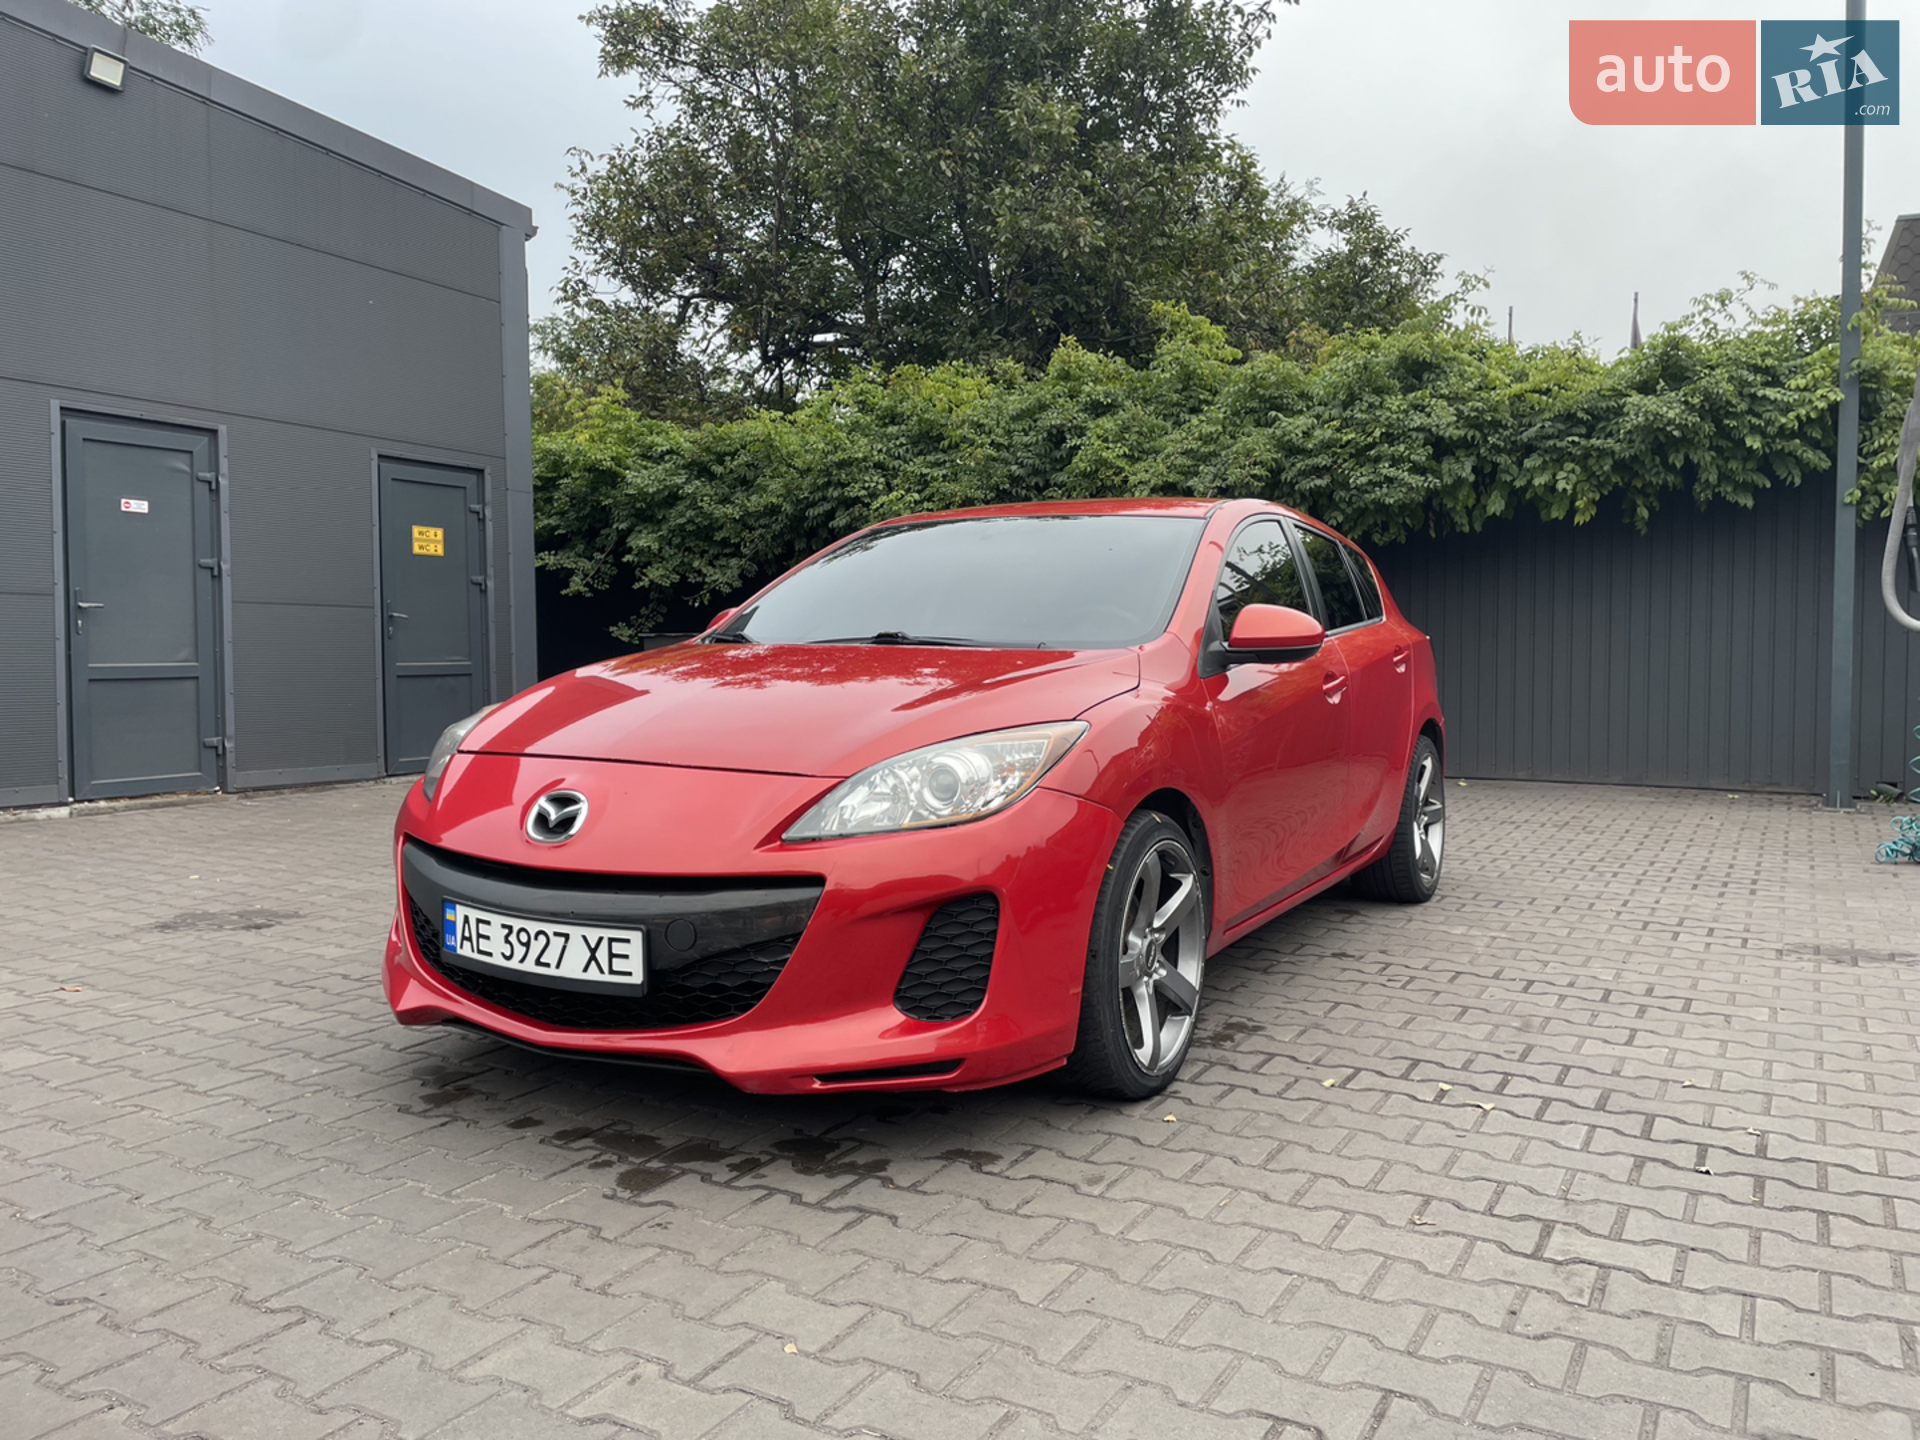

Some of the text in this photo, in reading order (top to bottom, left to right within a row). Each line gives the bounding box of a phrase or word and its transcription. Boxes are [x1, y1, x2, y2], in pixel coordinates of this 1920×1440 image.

[446, 934, 456, 946] UA
[459, 914, 633, 977] AE 3927 XE
